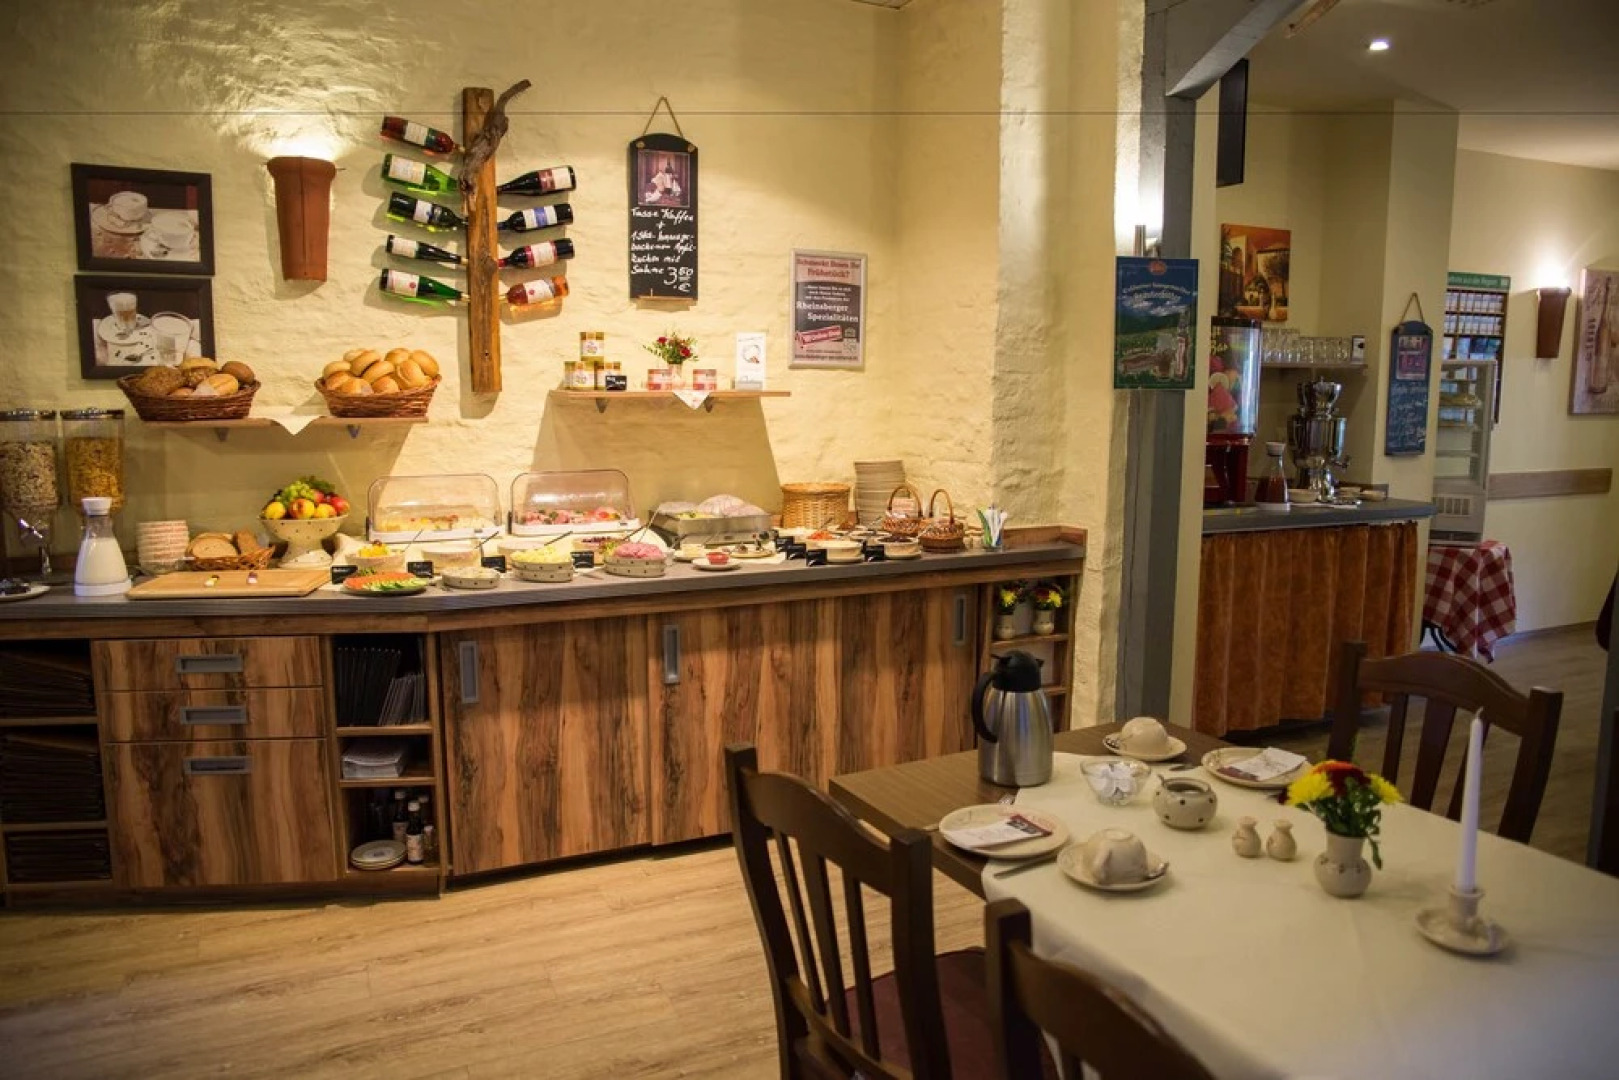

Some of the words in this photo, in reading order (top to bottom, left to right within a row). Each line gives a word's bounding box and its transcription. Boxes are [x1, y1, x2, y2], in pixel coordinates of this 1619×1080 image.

[631, 207, 659, 218] Tasse
[661, 208, 694, 225] Kaffee
[796, 300, 849, 312] Rheinsberger
[807, 312, 859, 323] Spezialitäten
